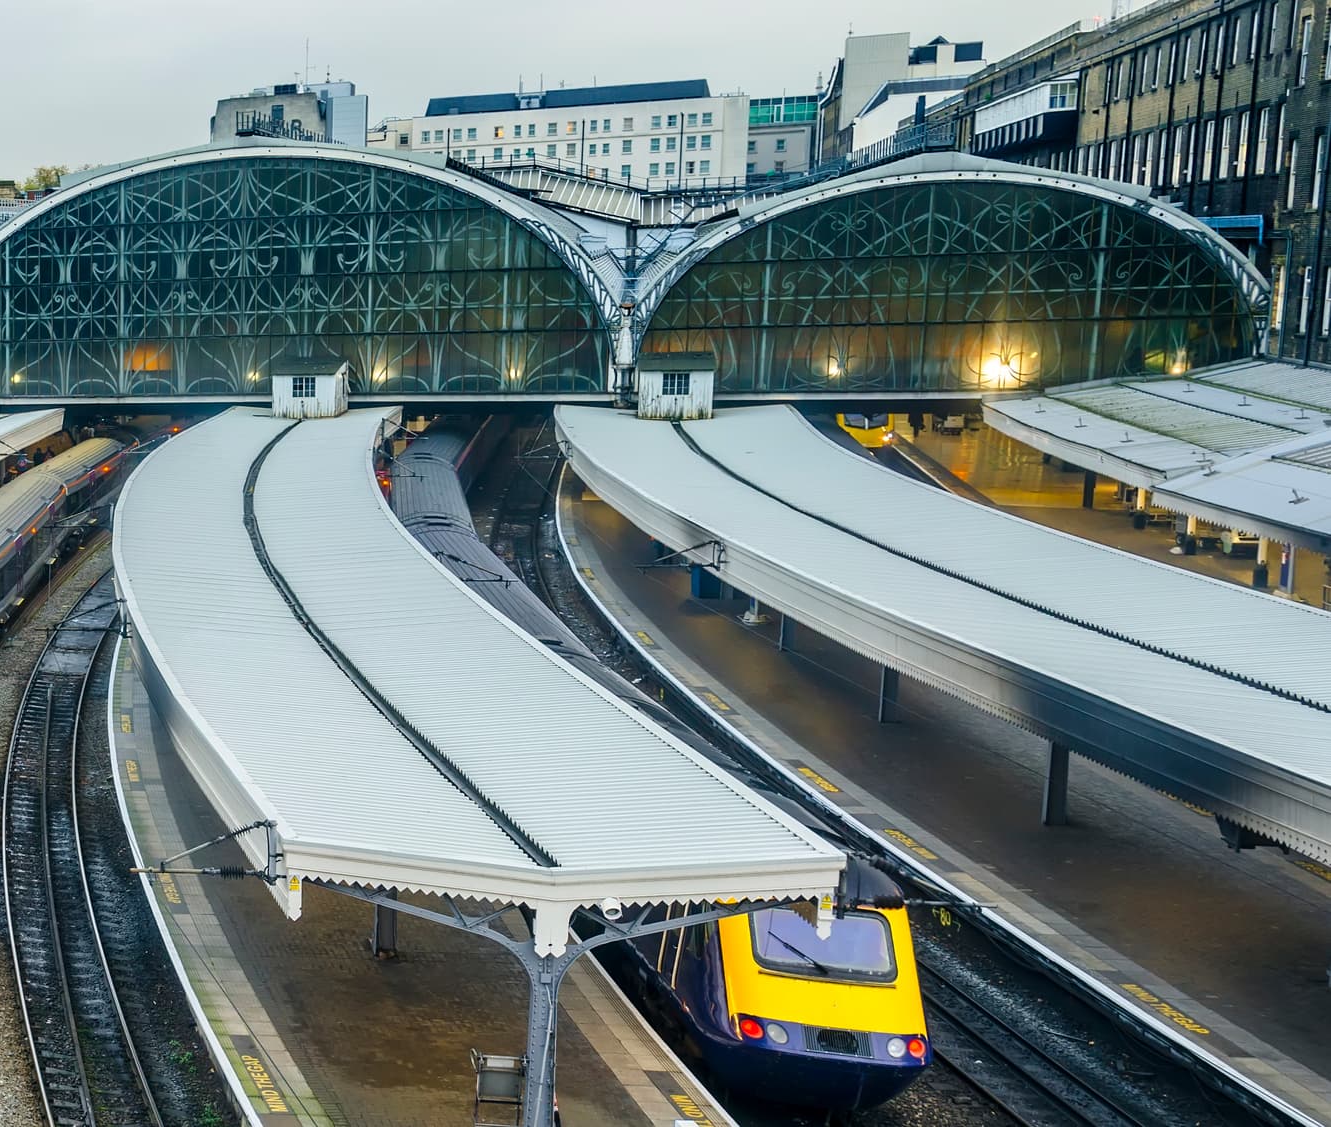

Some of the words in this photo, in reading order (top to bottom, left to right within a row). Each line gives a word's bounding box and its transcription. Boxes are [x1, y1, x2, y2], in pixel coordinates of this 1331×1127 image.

[1119, 983, 1159, 1003] MIND
[1150, 1003, 1185, 1018] THE
[1173, 1017, 1210, 1034] GAP
[241, 1055, 264, 1072] GAP
[250, 1072, 275, 1089] THE
[261, 1089, 289, 1112] MIND
[669, 1094, 704, 1118] MIND
